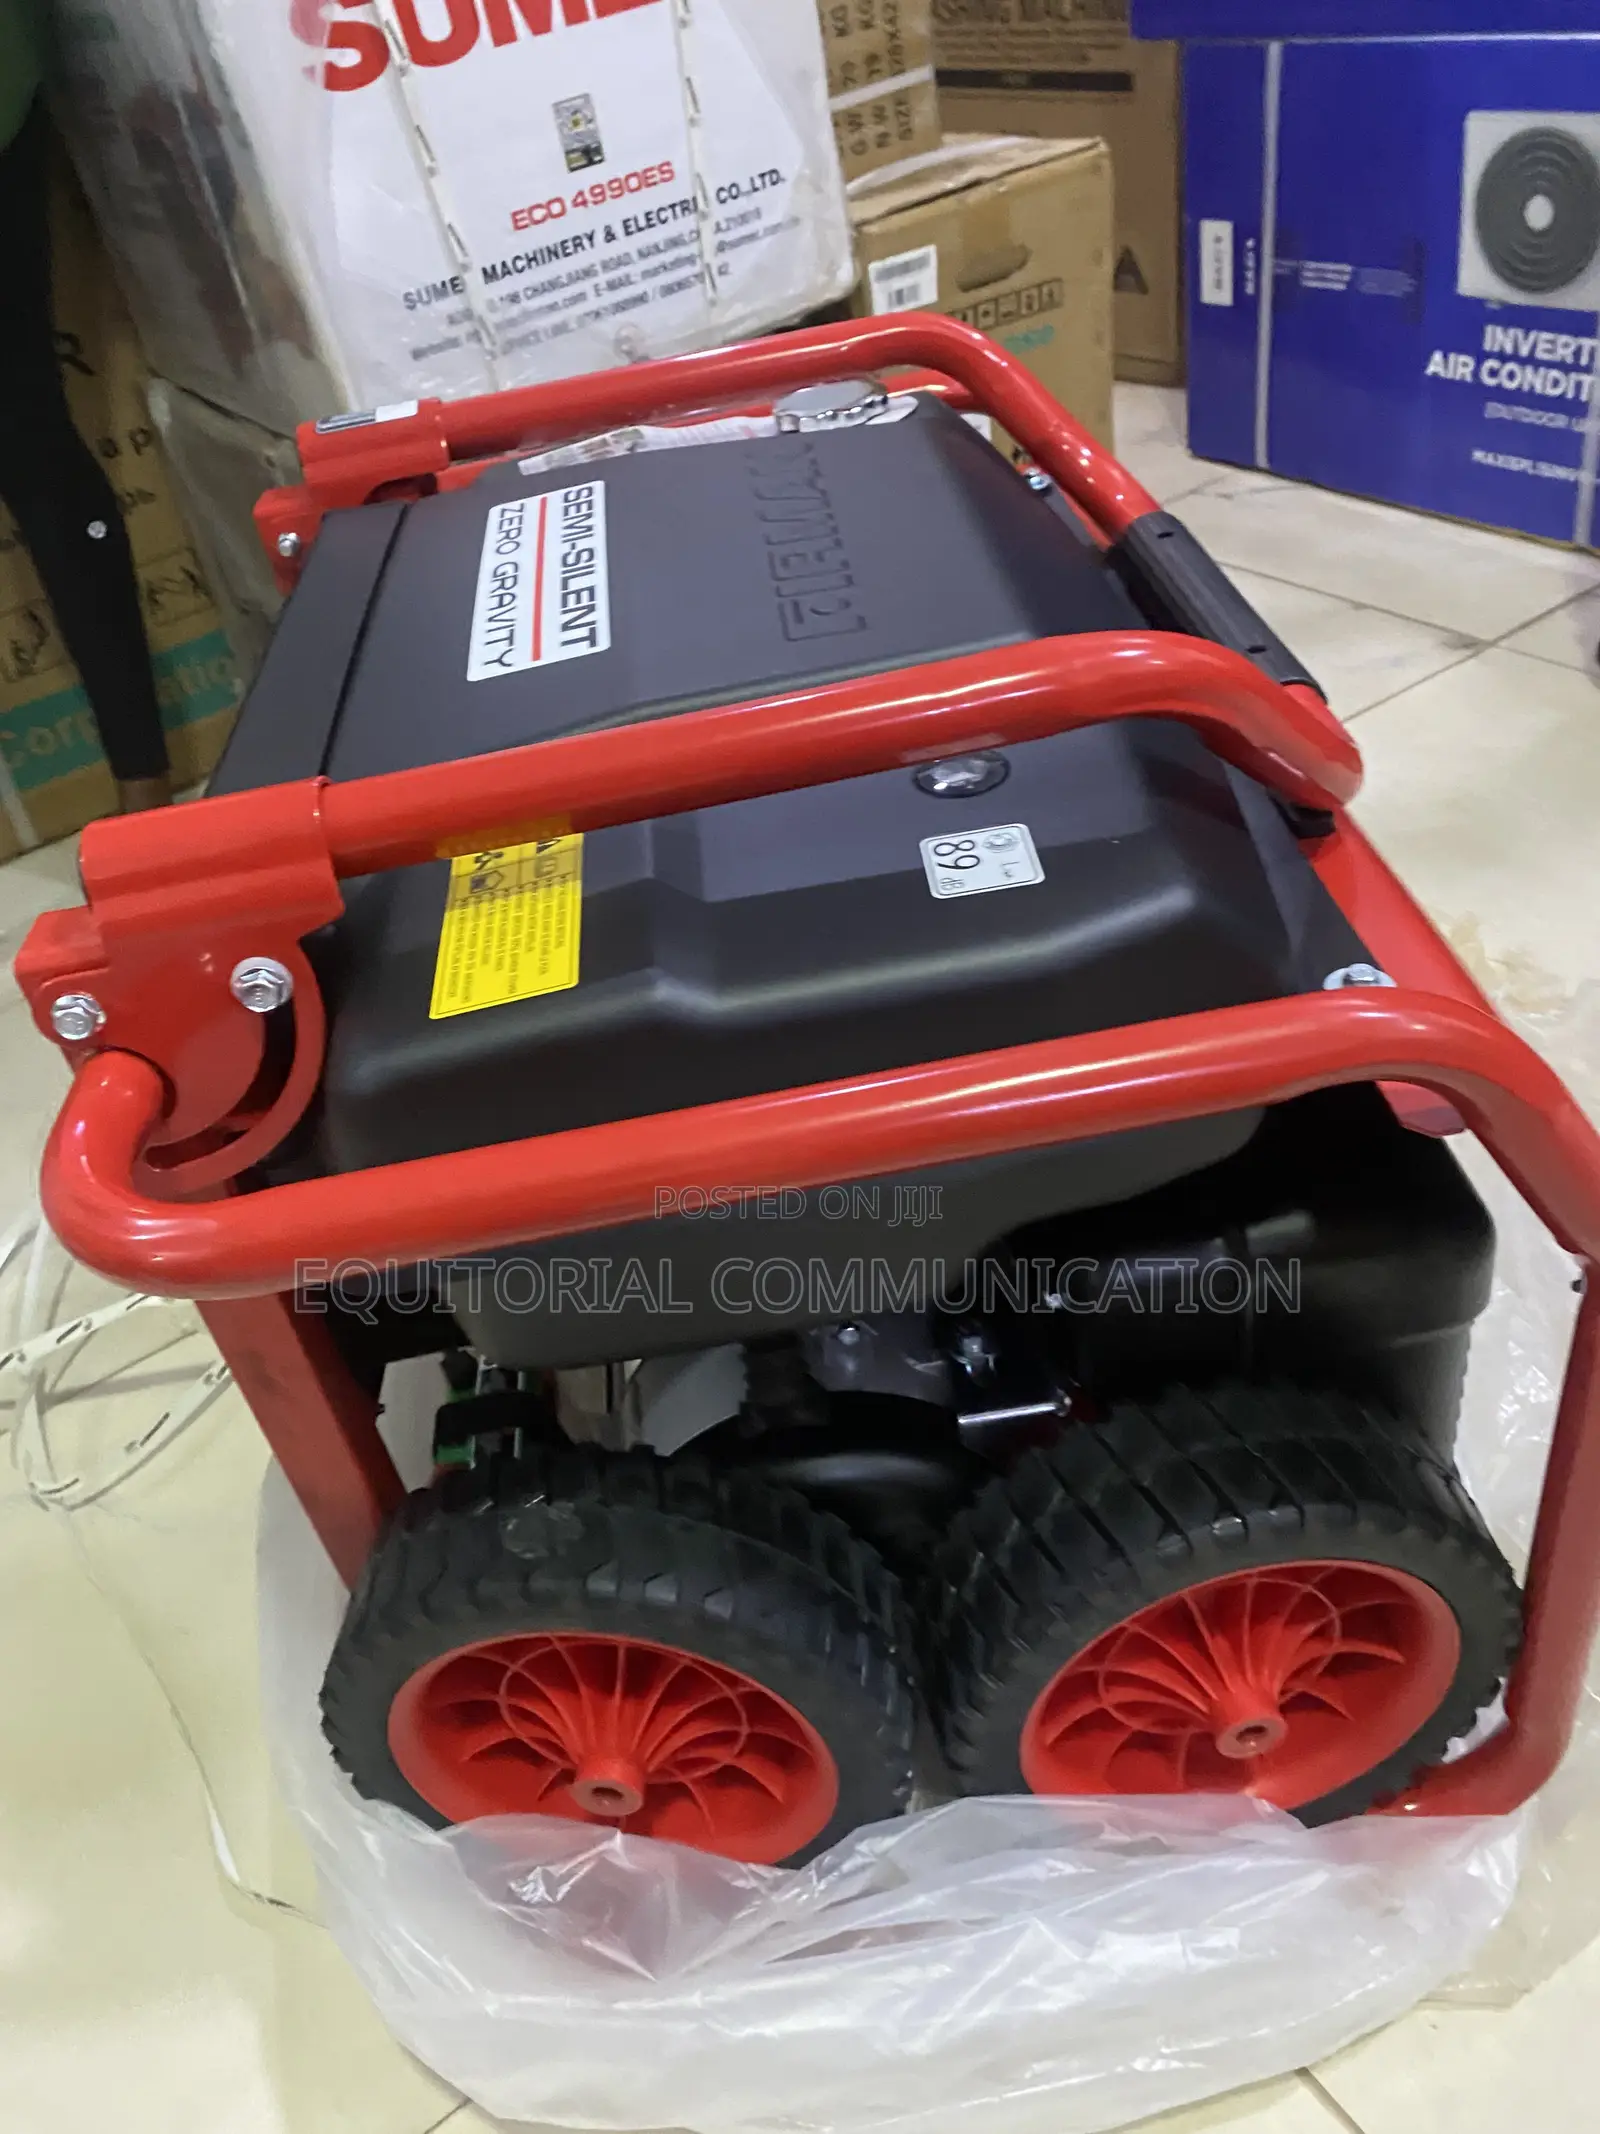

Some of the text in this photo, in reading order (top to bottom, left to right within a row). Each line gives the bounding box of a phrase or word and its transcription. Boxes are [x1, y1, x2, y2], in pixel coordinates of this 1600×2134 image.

[402, 275, 467, 311] SUME
[481, 229, 596, 284] MACHINERY
[604, 224, 617, 243] &
[622, 195, 703, 237] ELECTRI
[511, 161, 675, 231] ECO 4990ES
[1424, 350, 1475, 382] AIR
[484, 502, 525, 668] ZERO GRAVITY
[560, 486, 597, 649] SEMI-SILENT
